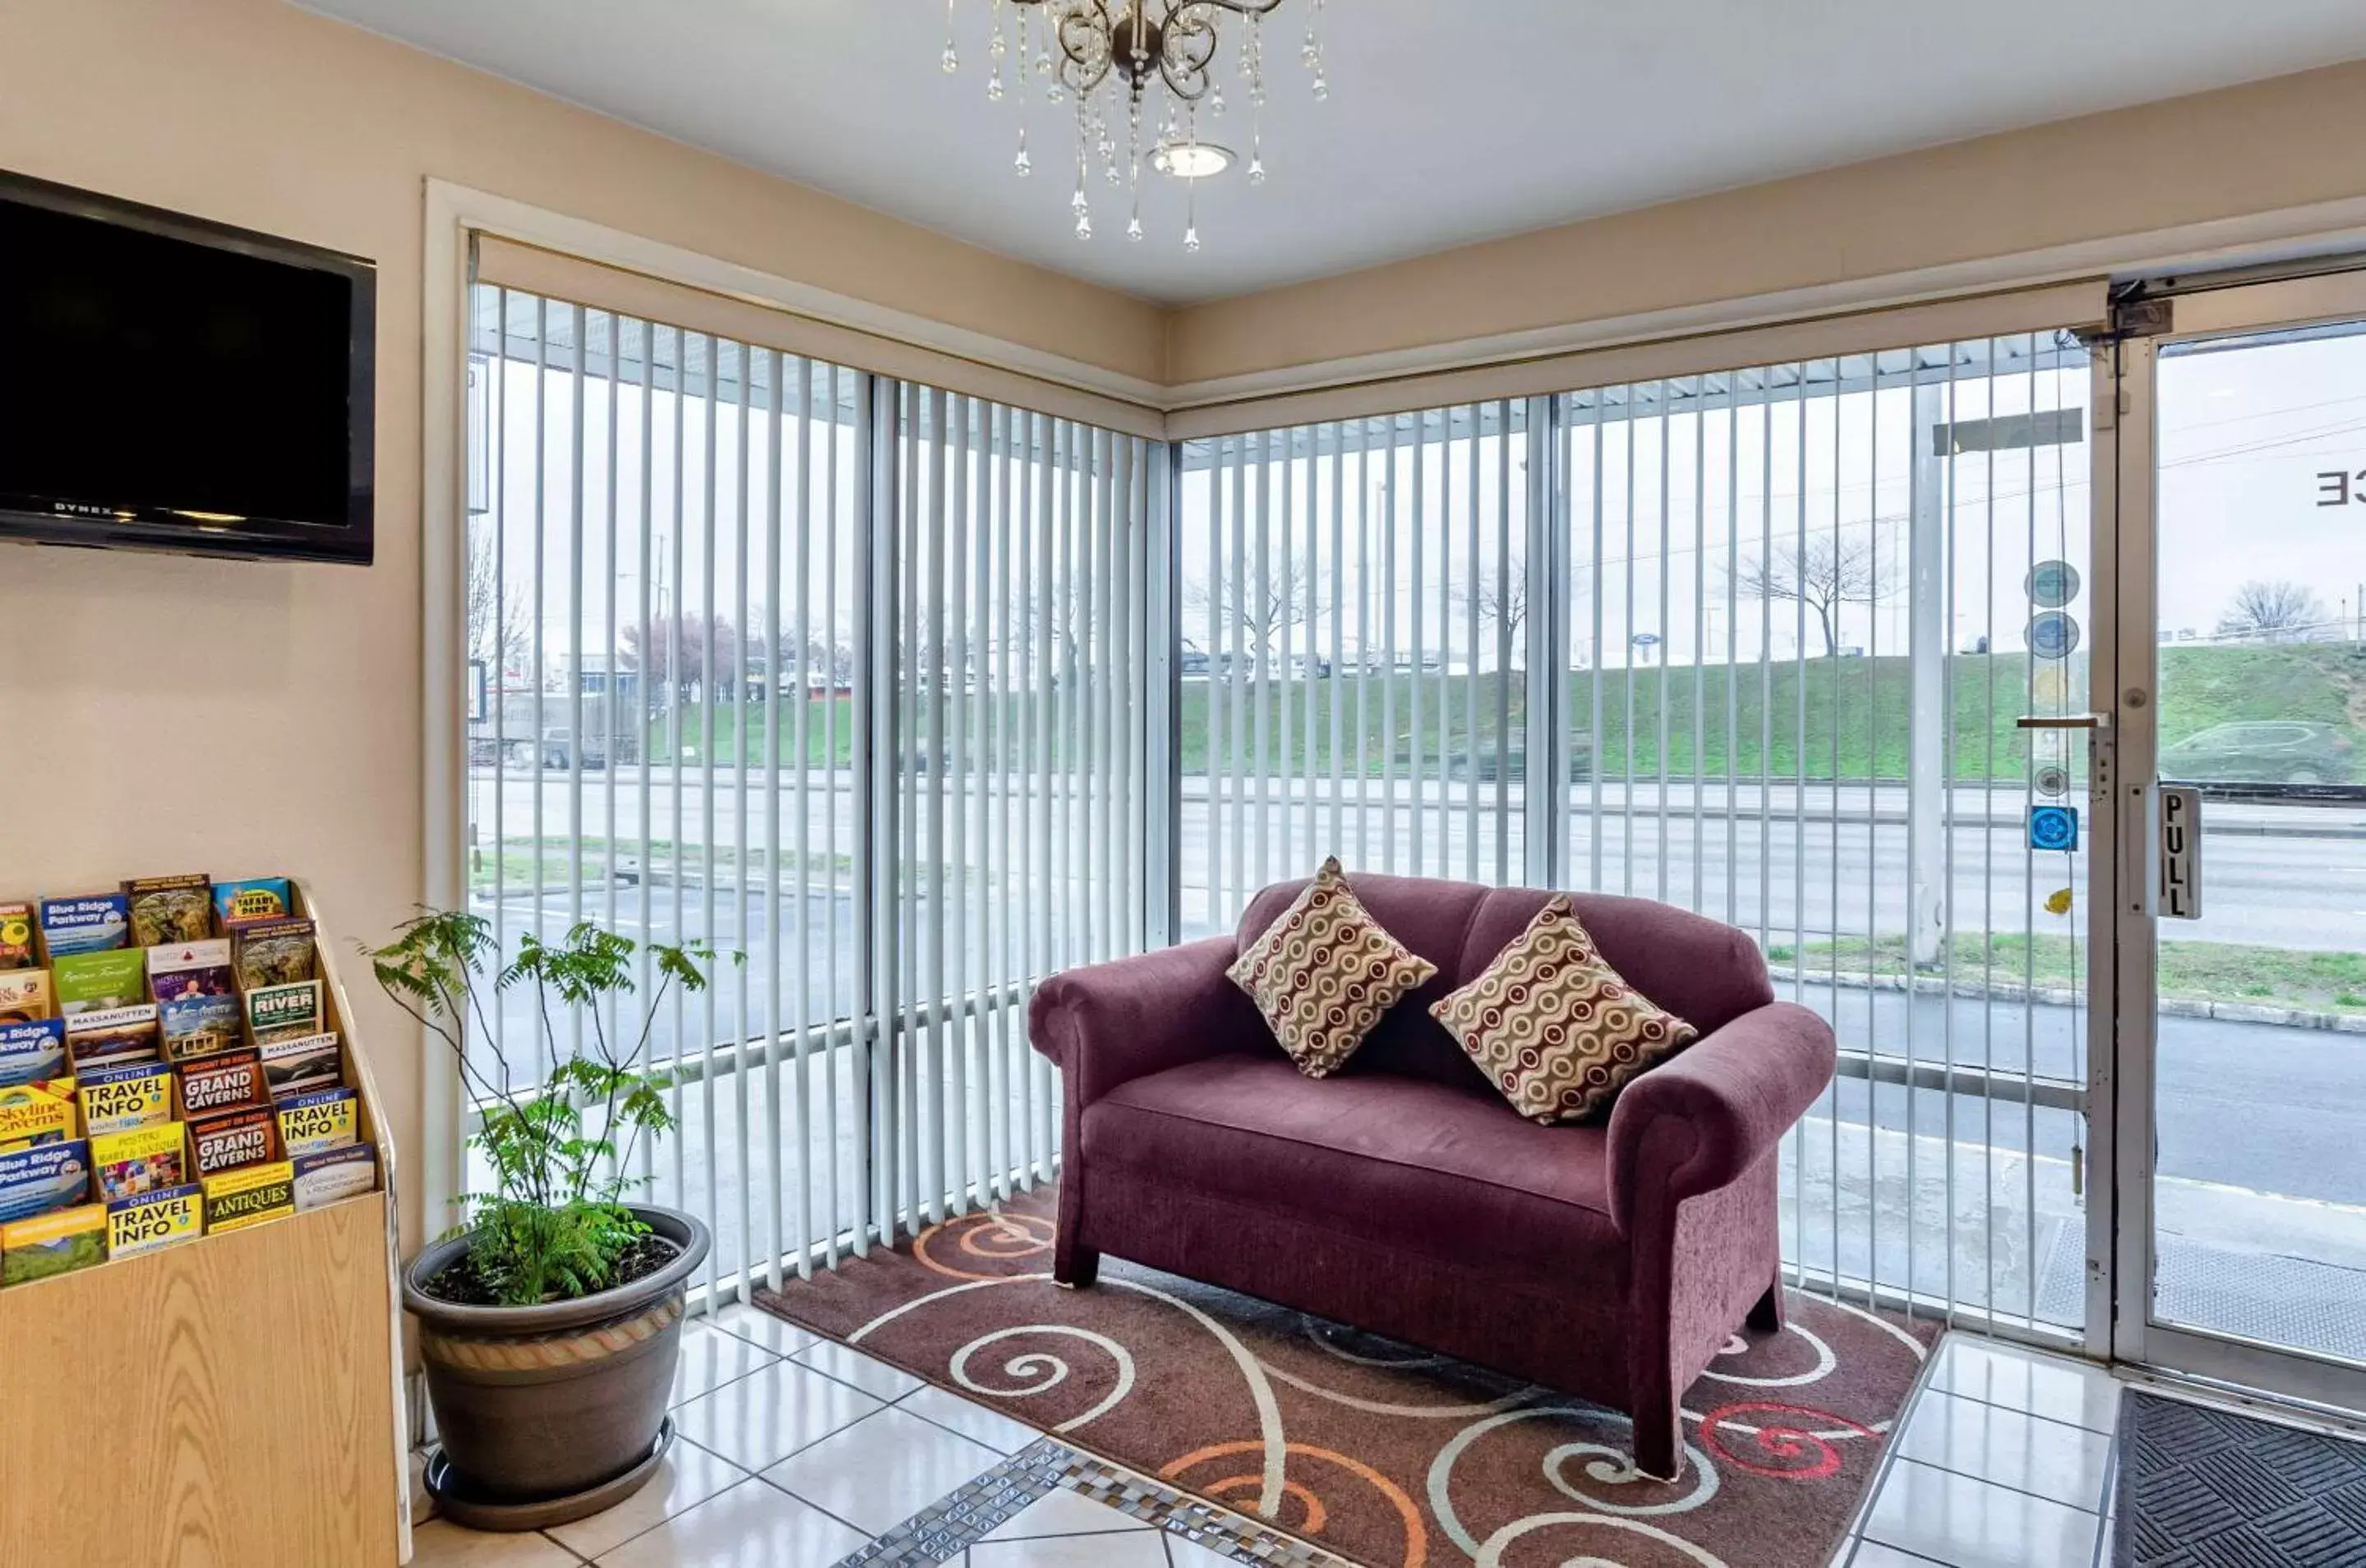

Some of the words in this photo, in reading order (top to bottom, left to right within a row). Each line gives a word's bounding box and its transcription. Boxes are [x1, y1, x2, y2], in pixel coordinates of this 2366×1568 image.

[54, 502, 112, 515] DYNEX
[2166, 795, 2185, 915] PULL
[48, 904, 76, 915] Blue
[77, 901, 113, 914] Ridge
[48, 912, 103, 926] Parkway
[255, 993, 313, 1013] RIVER
[72, 1008, 152, 1025] MASSANUTTEN
[10, 1026, 50, 1040] Ridge
[0, 1039, 36, 1053] kway
[267, 1035, 334, 1054] MASSANUTTEN
[104, 1068, 153, 1083] ONLINE
[186, 1072, 251, 1096] GRAND
[85, 1078, 164, 1103] TRAVEL
[186, 1086, 251, 1109] CAVERNS
[297, 1091, 340, 1106] ONLINE
[89, 1098, 144, 1119] INFO
[283, 1104, 348, 1126] TRAVEL
[285, 1121, 332, 1141] INFO
[200, 1130, 265, 1157] GRAND
[30, 1149, 72, 1165] Ridge
[200, 1145, 266, 1172] CAVERNS
[129, 1189, 180, 1207] ONLINE
[214, 1185, 287, 1217] ANTIQUES
[112, 1200, 191, 1230] TRAVEL
[115, 1220, 171, 1247] INFO
